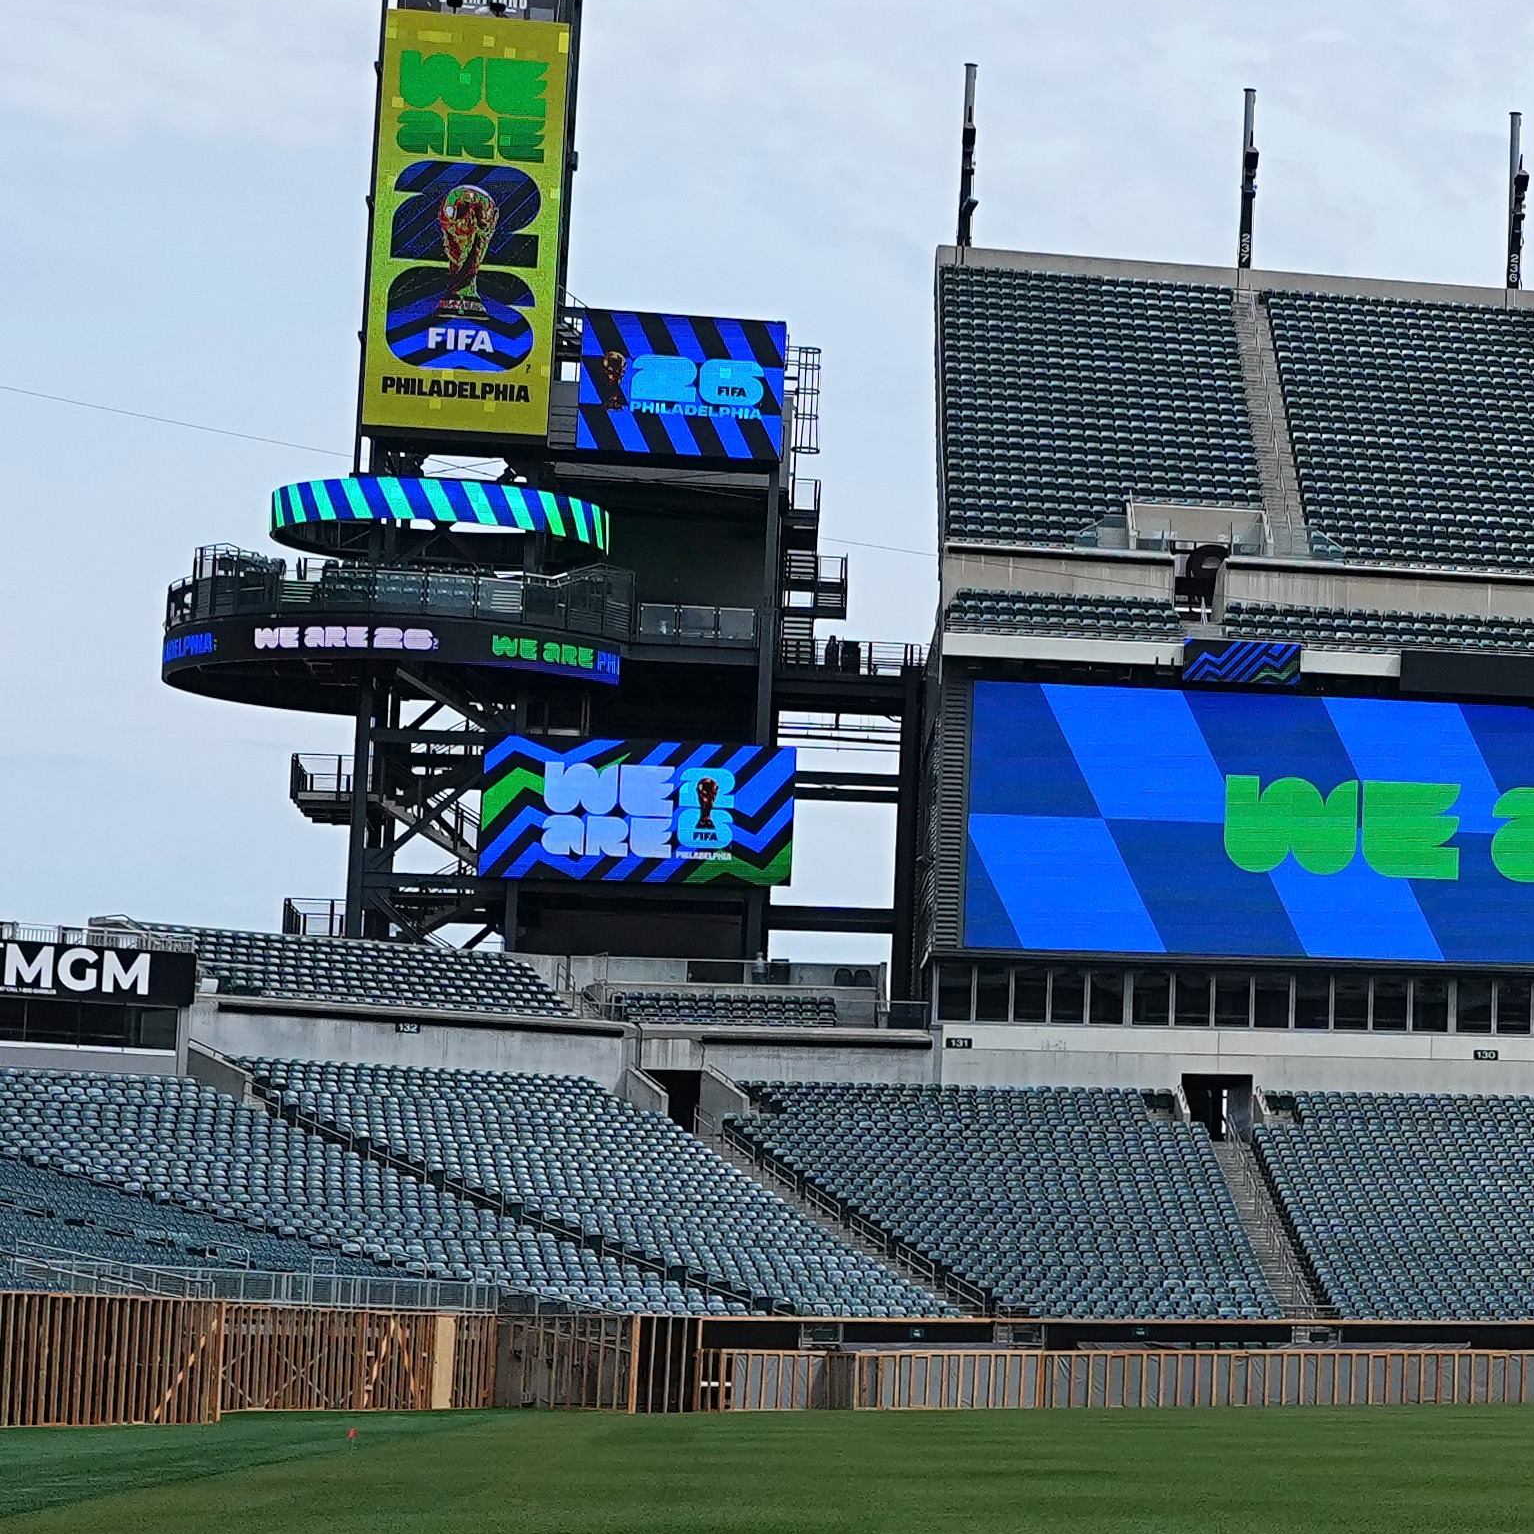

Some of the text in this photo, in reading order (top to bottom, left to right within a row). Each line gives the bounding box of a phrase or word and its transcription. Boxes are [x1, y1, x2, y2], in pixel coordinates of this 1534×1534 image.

[400, 50, 550, 119] WE
[427, 327, 494, 354] FIFA
[381, 376, 531, 403] PHILADELPHIA
[631, 354, 765, 406] 26
[717, 386, 747, 398] FIFA
[630, 401, 762, 420] PHILADELPHIA
[254, 626, 299, 649] WE
[373, 627, 434, 650] 26
[492, 634, 538, 661] WE
[544, 761, 676, 818] WE
[693, 832, 718, 842] FIFA
[1223, 774, 1460, 881] WE
[0, 943, 151, 996] MGM
[399, 1022, 418, 1033] 132
[950, 1039, 968, 1048] 131
[1476, 1050, 1496, 1059] 130
